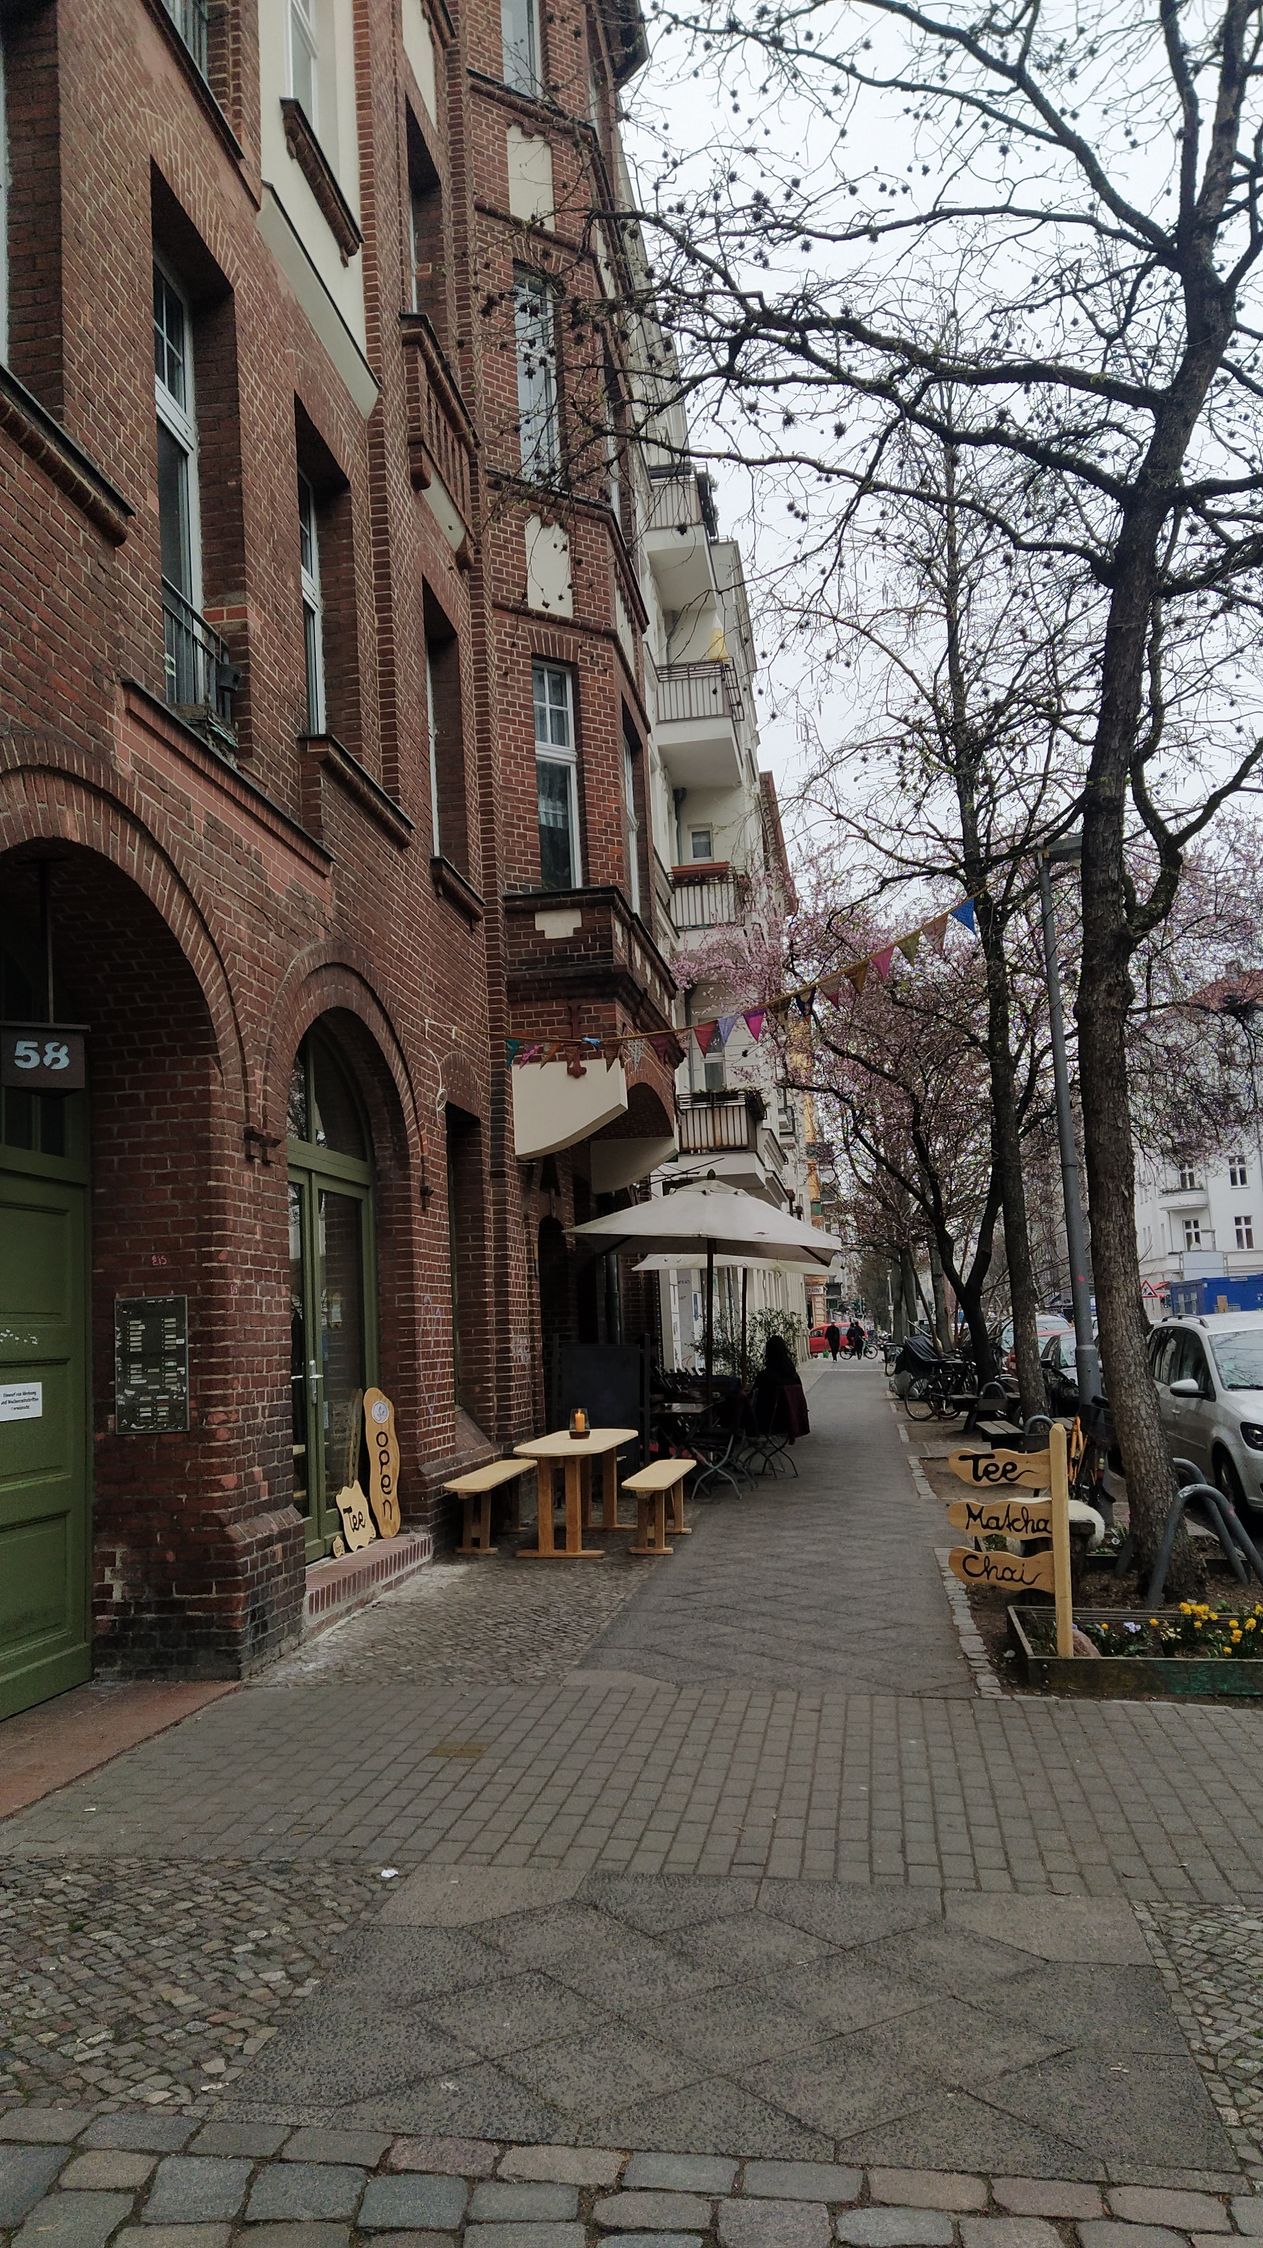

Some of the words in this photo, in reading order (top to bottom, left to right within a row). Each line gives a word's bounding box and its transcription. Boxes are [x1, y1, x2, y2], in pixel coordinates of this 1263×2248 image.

[14, 1040, 70, 1070] 58
[376, 1431, 393, 1521] open
[958, 1453, 1039, 1482] Tee
[343, 1506, 366, 1533] Tee
[965, 1503, 1052, 1534] Matcha
[962, 1554, 1042, 1585] Chai
